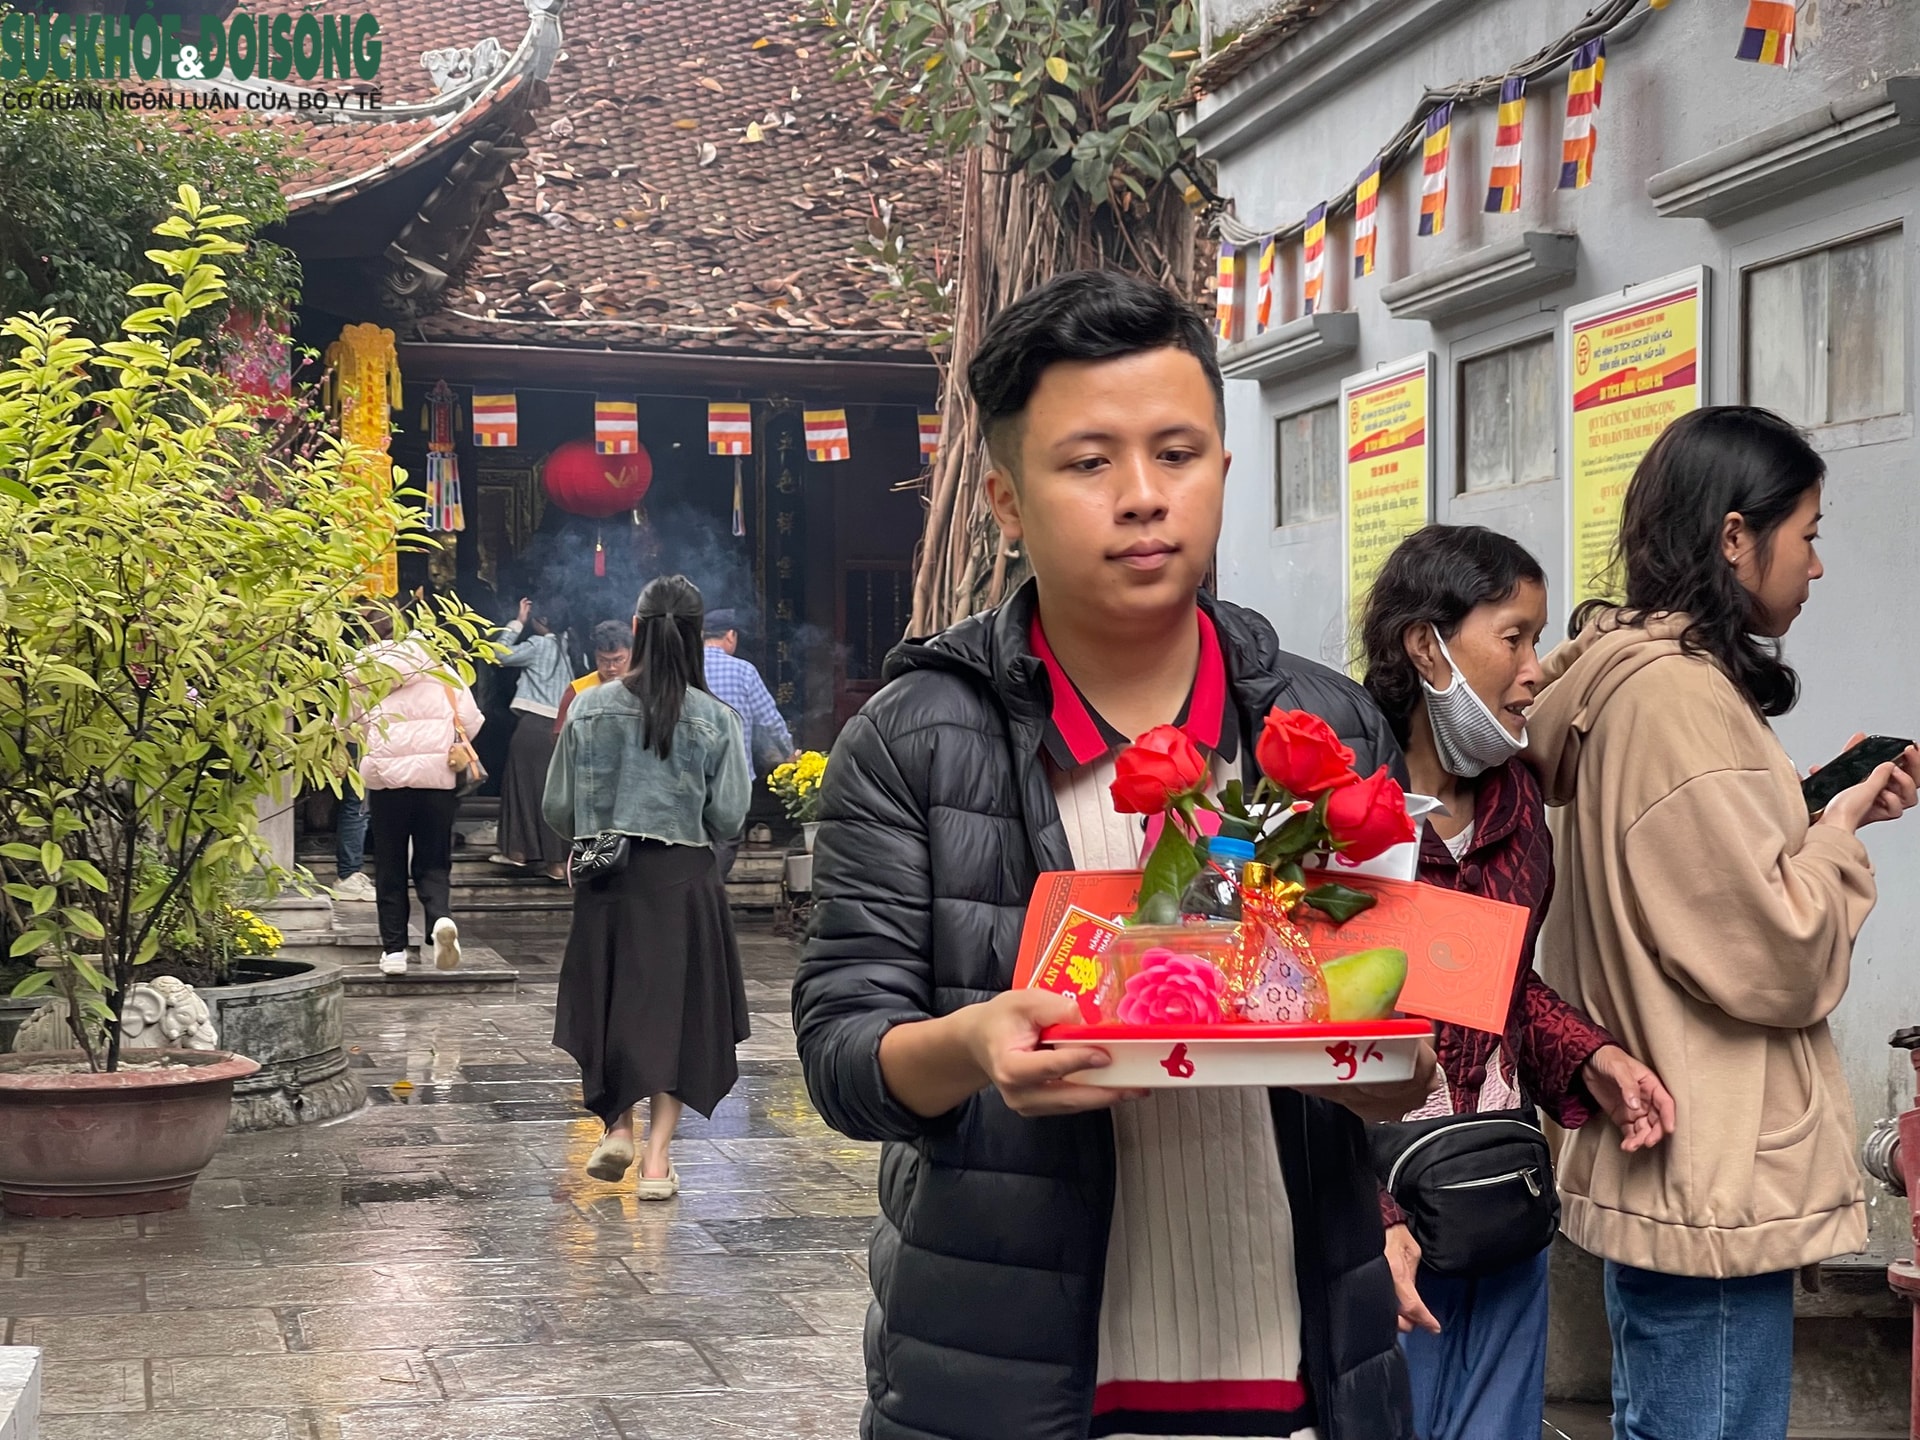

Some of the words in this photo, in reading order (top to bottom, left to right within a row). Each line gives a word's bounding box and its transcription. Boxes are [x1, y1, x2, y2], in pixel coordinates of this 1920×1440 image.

[1088, 928, 1104, 951] HÀNG
[1097, 932, 1113, 953] THAN
[1043, 966, 1060, 987] AN
[1053, 932, 1078, 968] NINH
